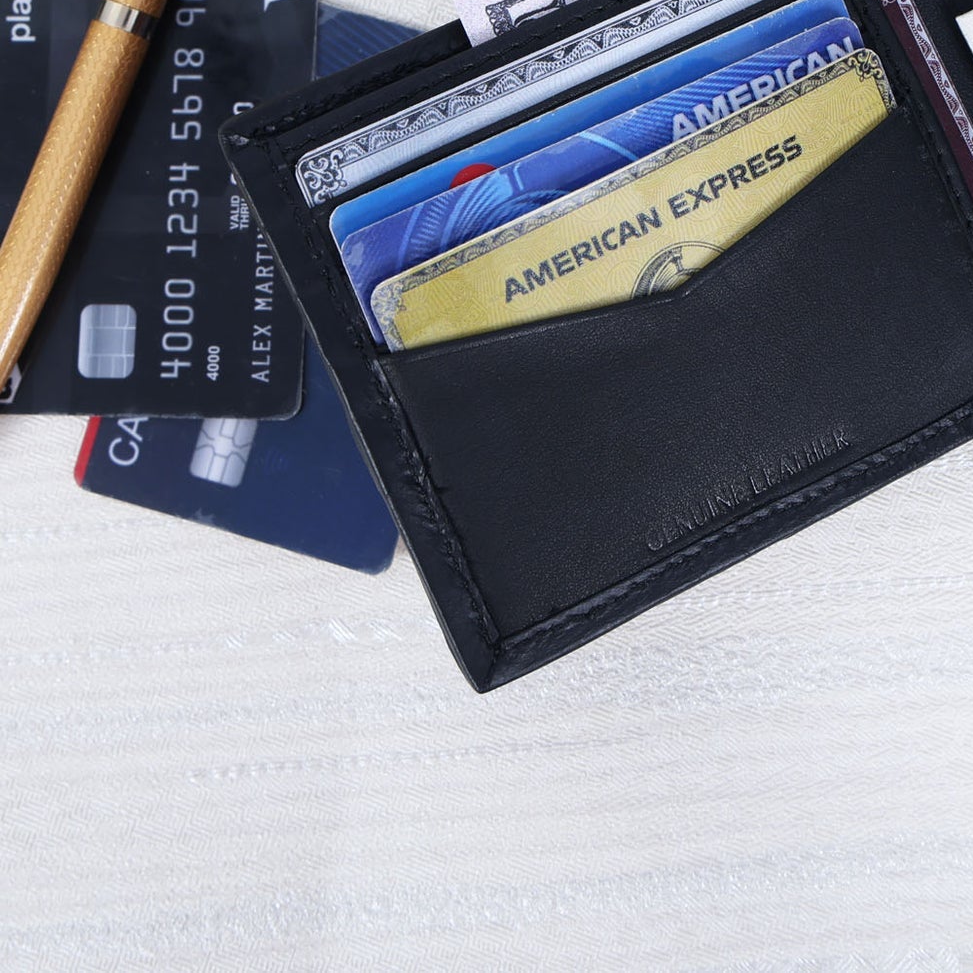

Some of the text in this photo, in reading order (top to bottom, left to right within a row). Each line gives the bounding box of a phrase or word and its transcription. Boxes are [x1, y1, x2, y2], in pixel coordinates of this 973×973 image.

[171, 47, 204, 141] 5678
[671, 36, 855, 142] AMERICAN
[166, 162, 200, 258] 1234
[229, 195, 241, 230] VALID
[504, 135, 804, 304] AMERICAN EXPRESS
[160, 278, 196, 379] 4000
[206, 345, 220, 381] 4000
[250, 324, 273, 383] ALEX
[647, 428, 850, 551] GENUINE LEATHER
